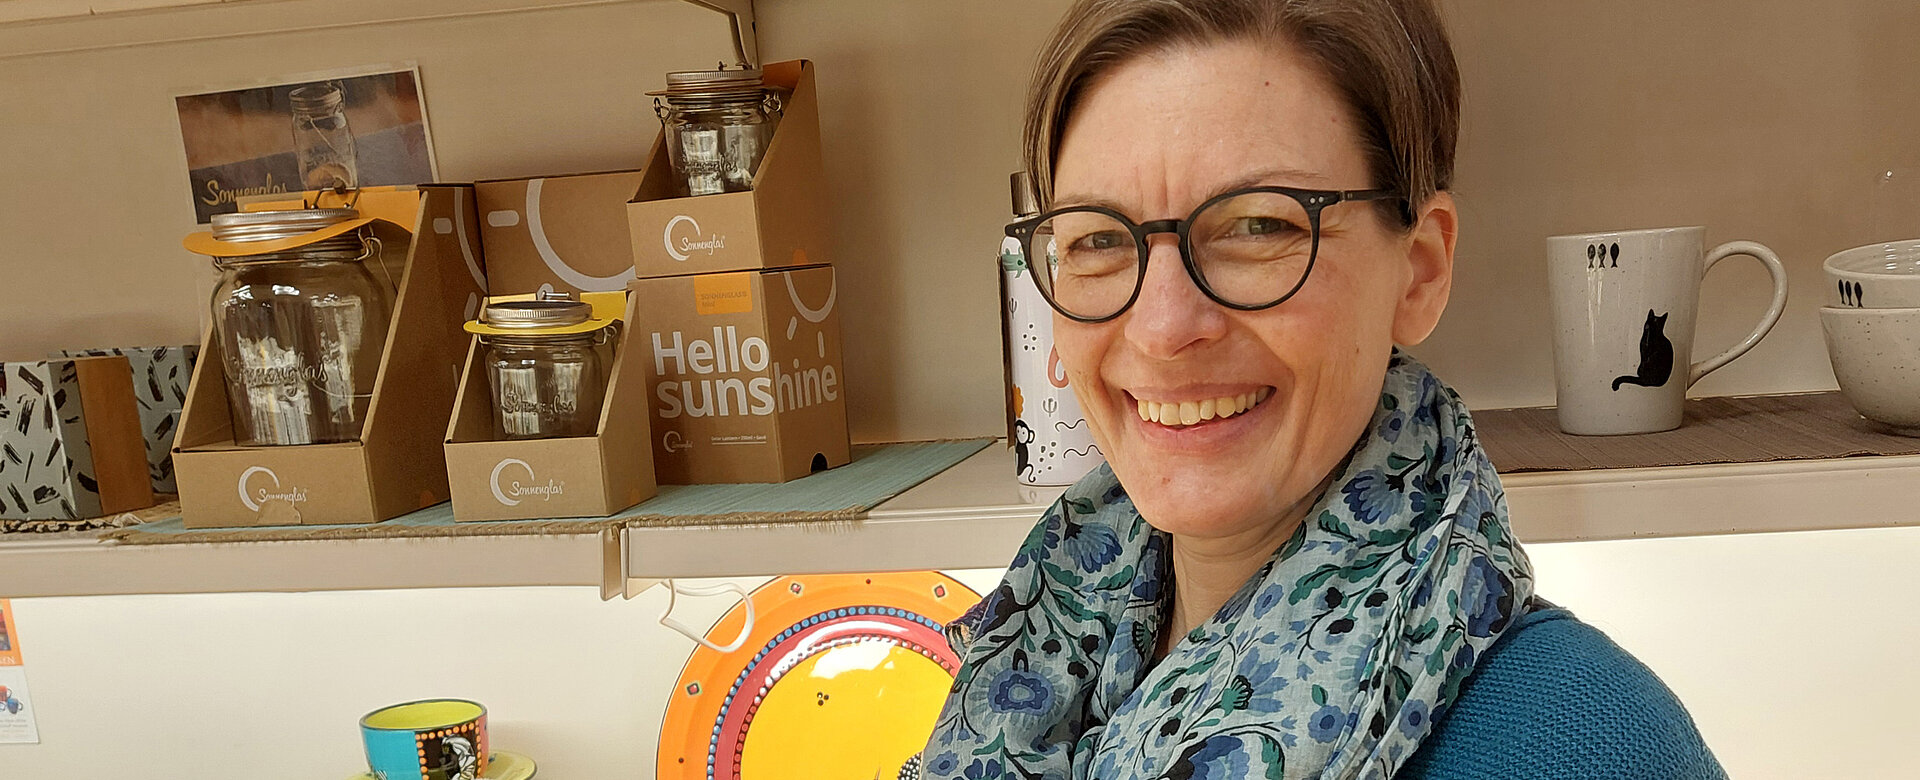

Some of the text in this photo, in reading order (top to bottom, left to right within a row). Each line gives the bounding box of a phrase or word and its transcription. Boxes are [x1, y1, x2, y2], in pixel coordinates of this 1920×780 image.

[679, 233, 726, 256] Sonnenglas
[651, 325, 770, 376] Hello
[656, 358, 838, 419] sunshine
[508, 478, 565, 502] Sonnenglas
